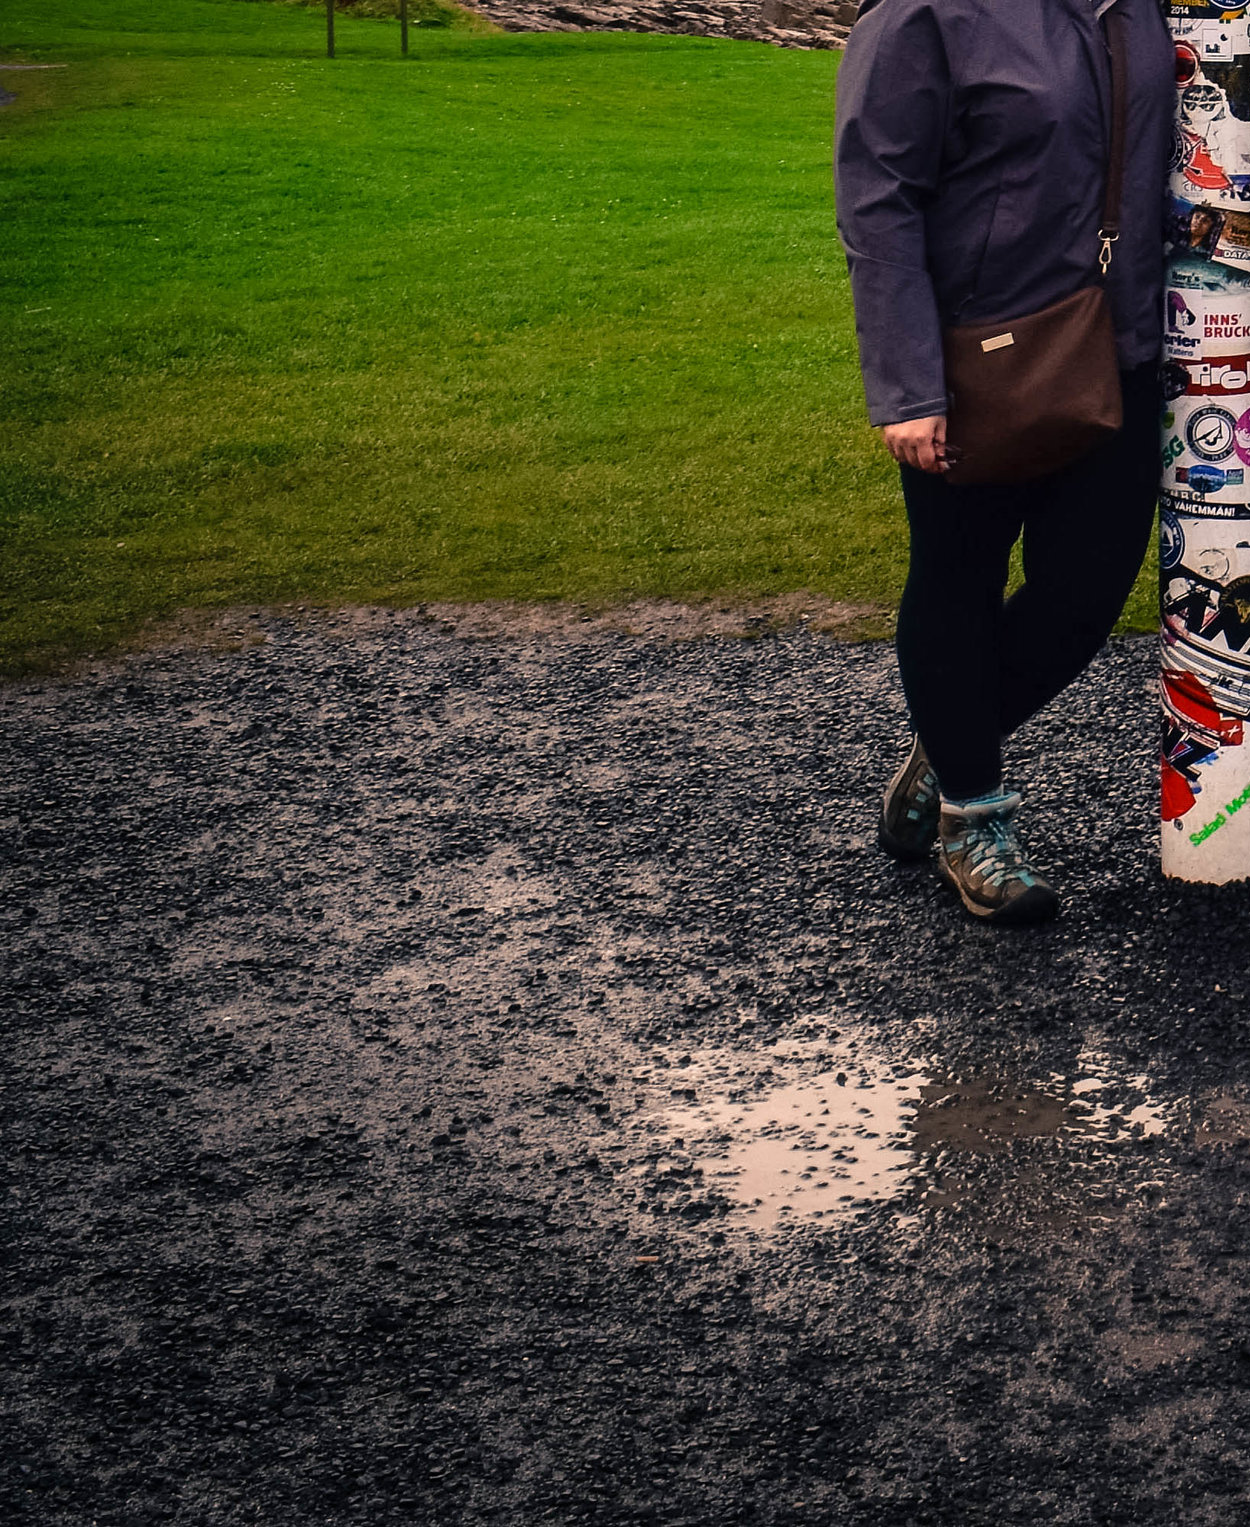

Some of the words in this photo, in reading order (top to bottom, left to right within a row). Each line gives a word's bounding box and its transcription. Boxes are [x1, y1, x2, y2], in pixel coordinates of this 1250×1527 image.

[1171, 6, 1190, 15] 2014
[1203, 314, 1243, 326] INNS'
[1203, 326, 1250, 339] BRUCK
